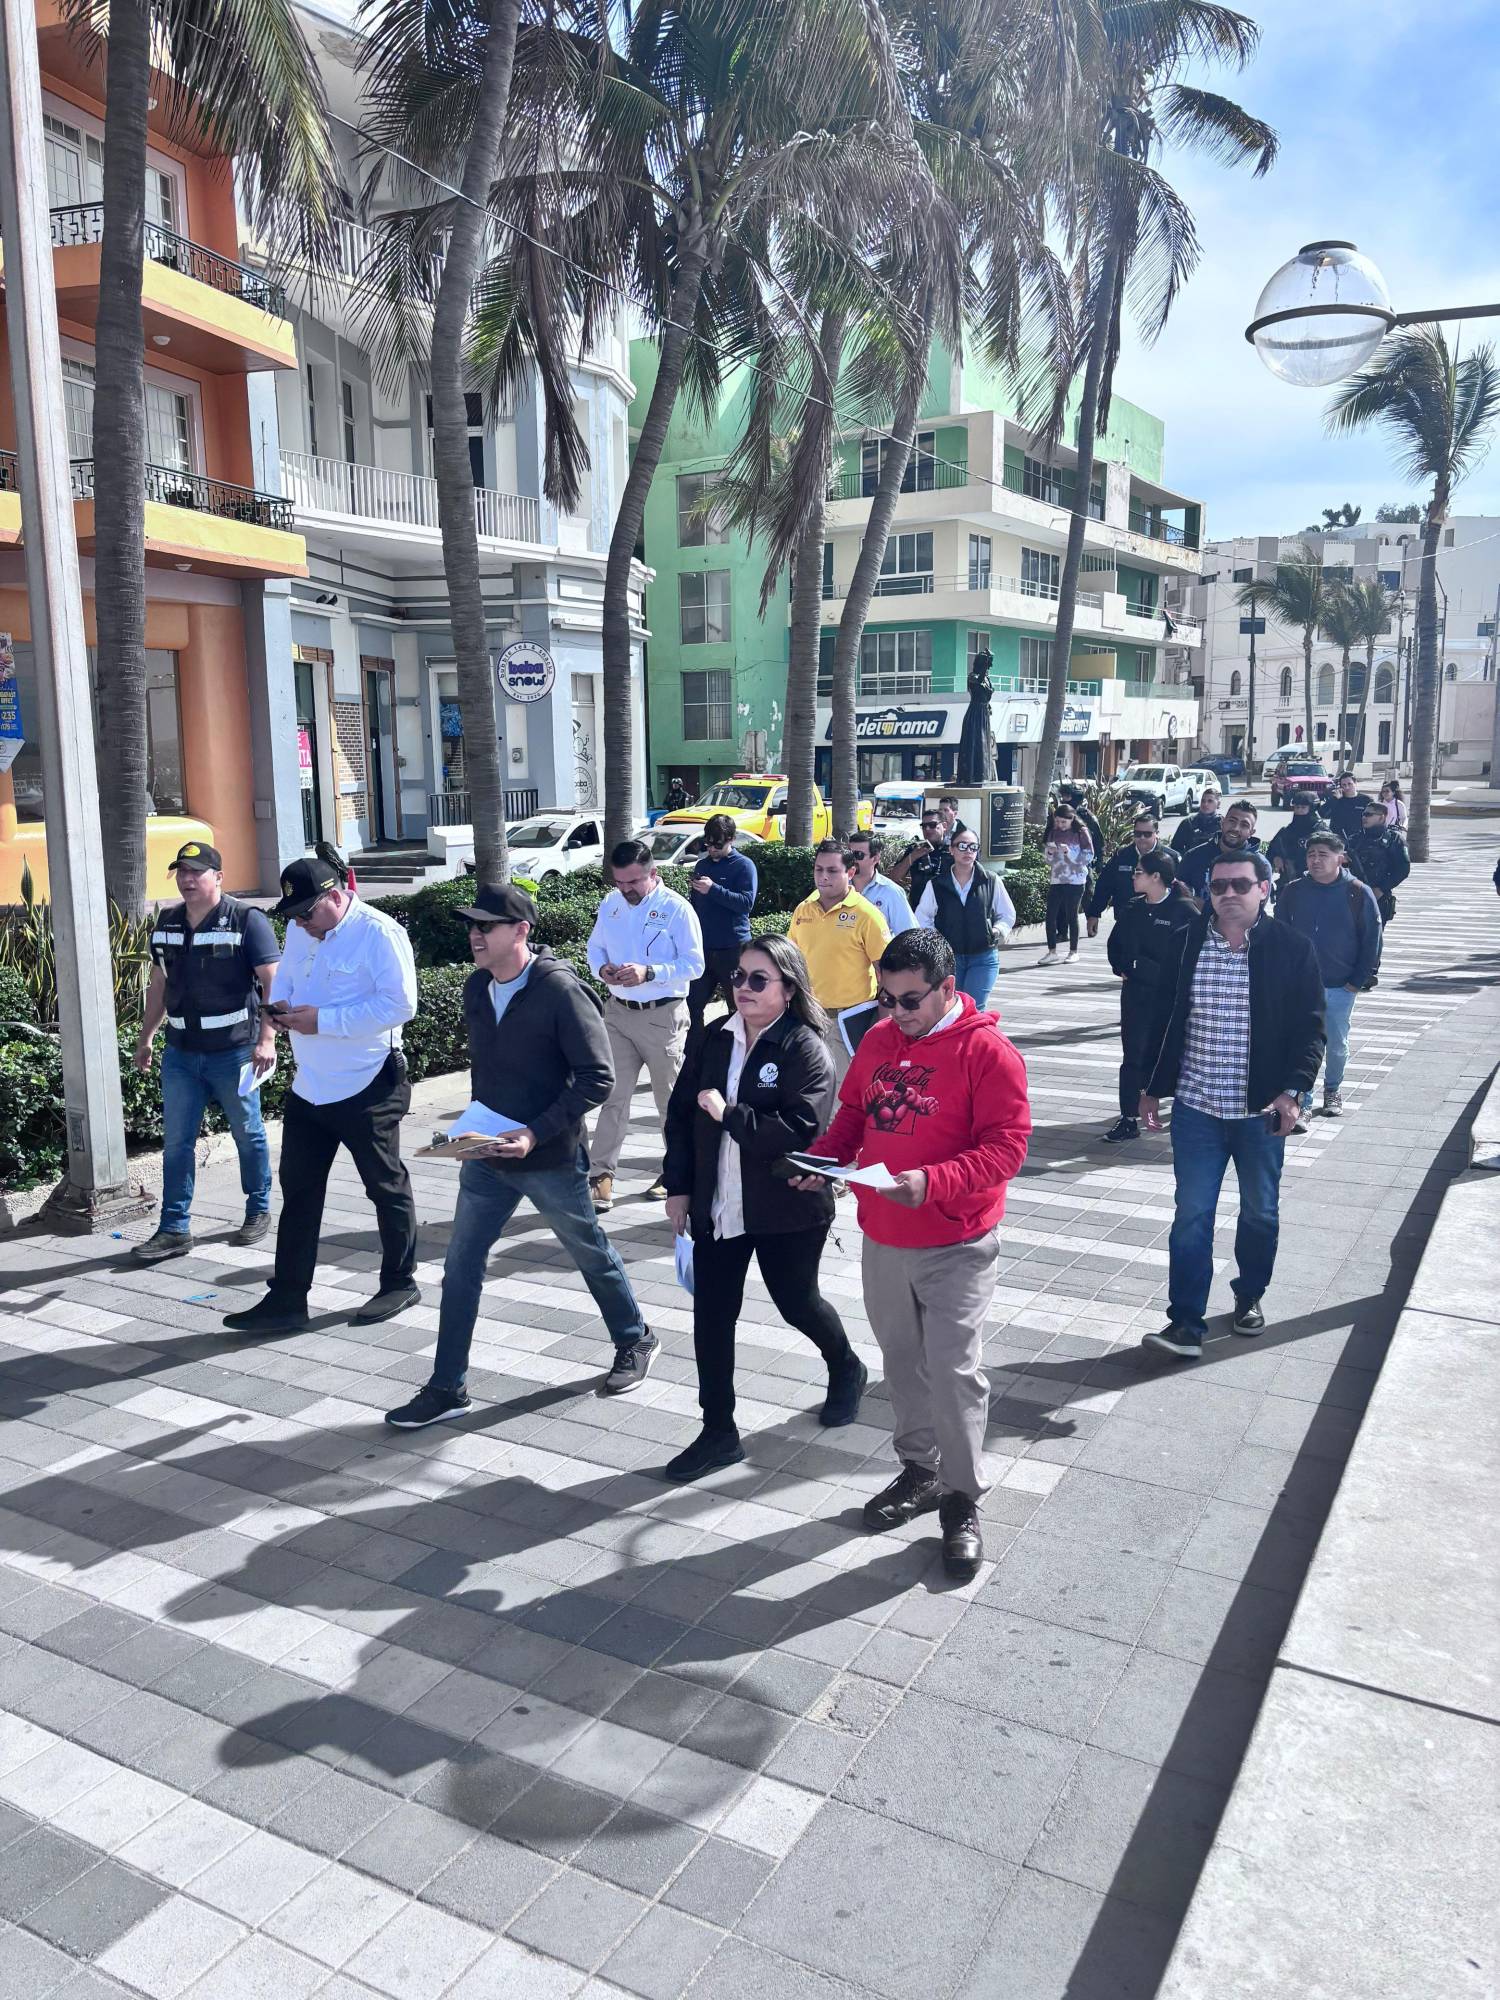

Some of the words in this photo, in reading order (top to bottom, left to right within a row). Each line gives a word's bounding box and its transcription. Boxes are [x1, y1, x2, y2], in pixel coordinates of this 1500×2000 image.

[508, 660, 544, 674] boba
[508, 674, 546, 687] snow
[855, 713, 939, 736] delorama
